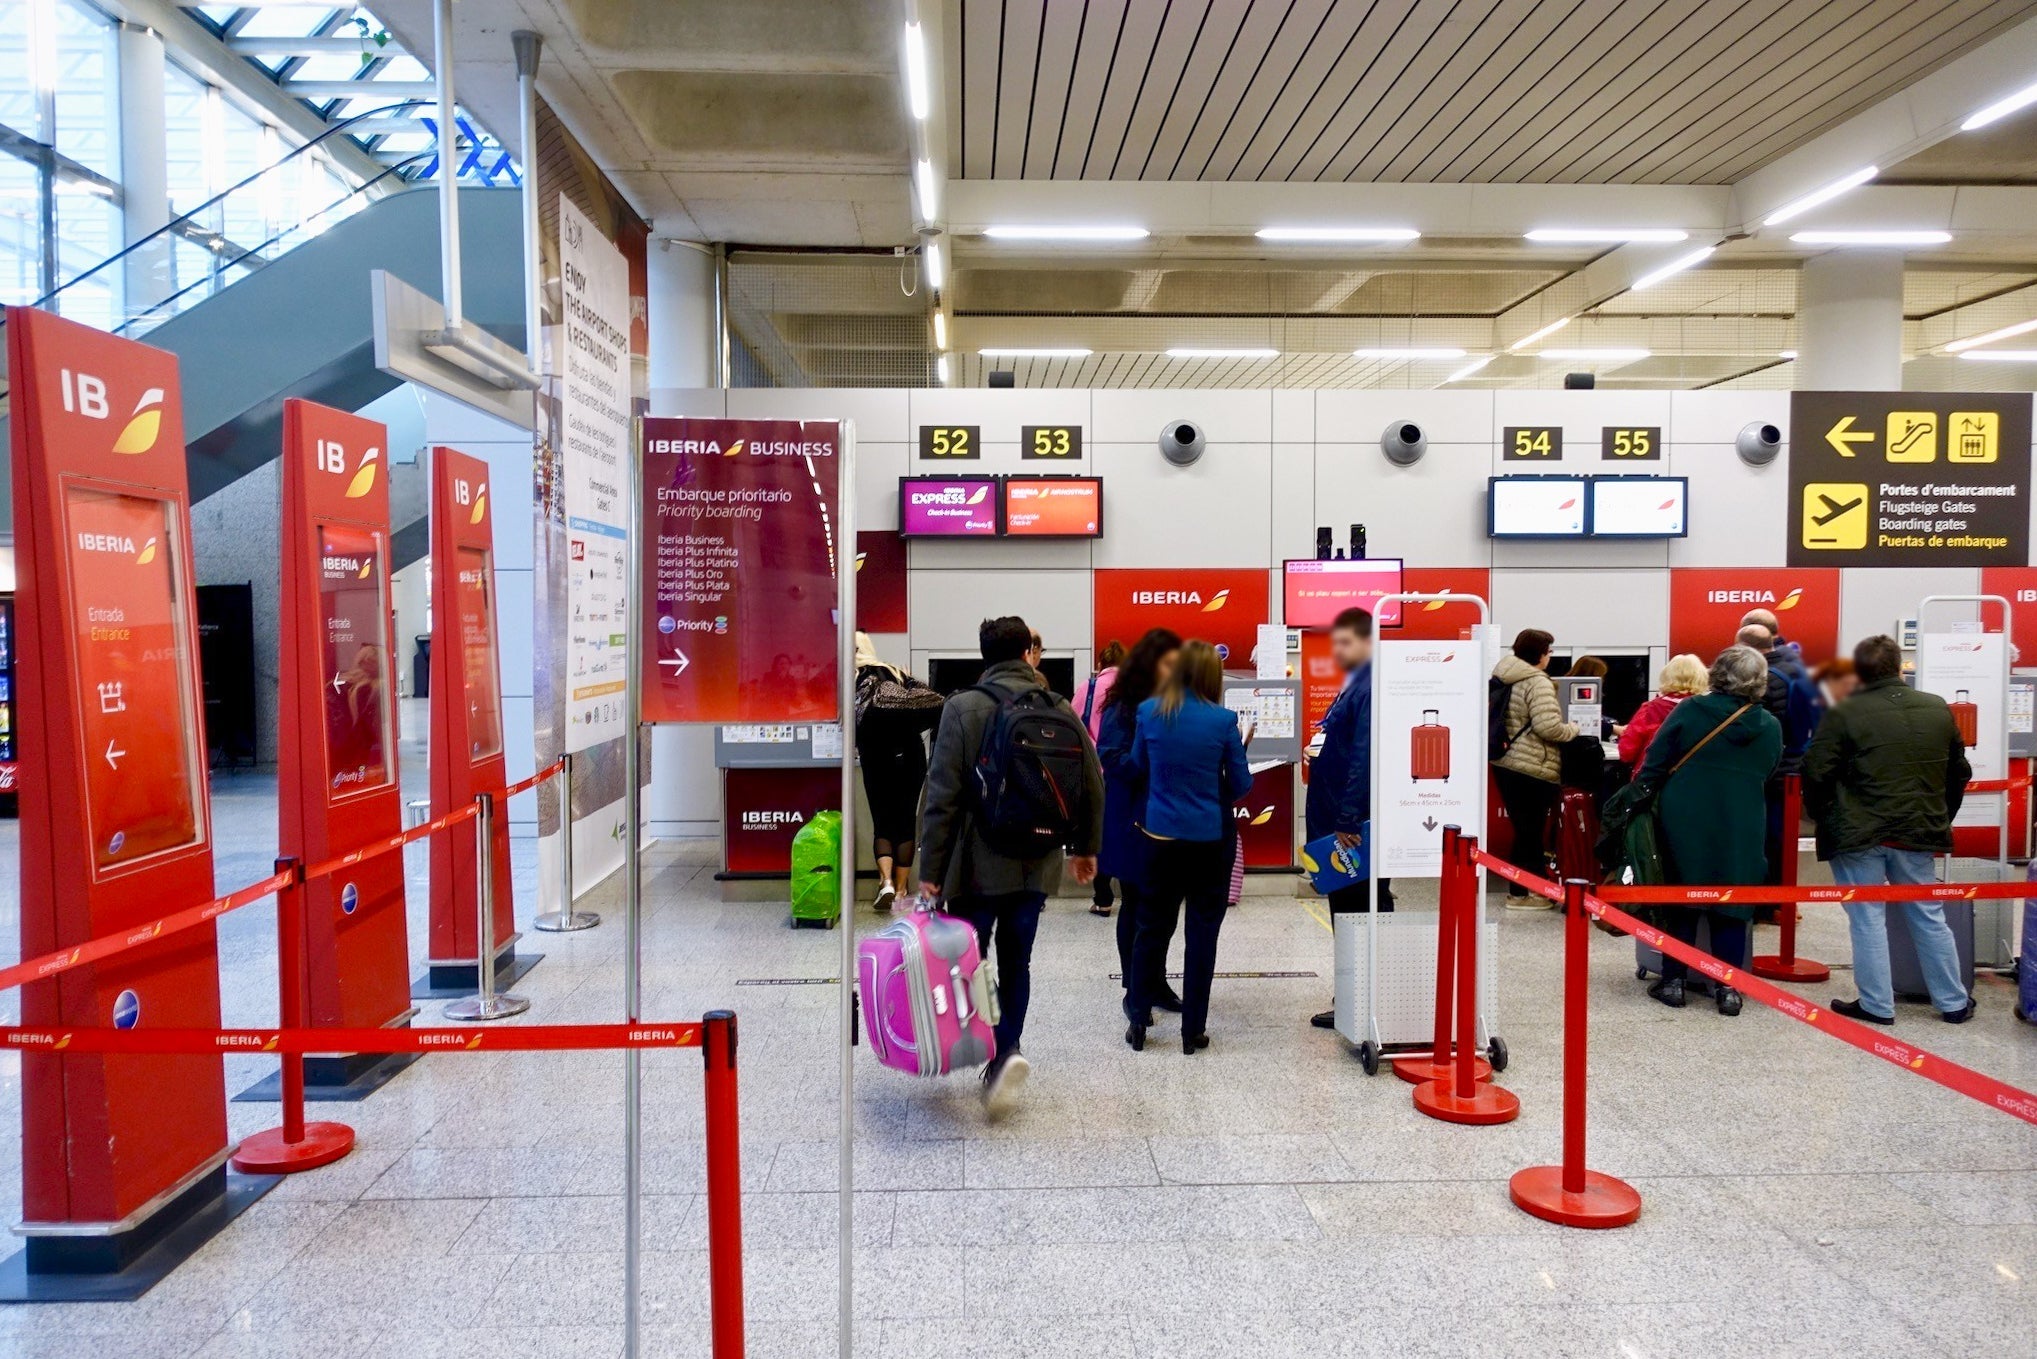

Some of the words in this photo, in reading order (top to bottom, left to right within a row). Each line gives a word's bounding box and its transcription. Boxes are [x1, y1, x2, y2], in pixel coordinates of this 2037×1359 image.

[566, 262, 586, 294] ENJOY
[566, 292, 580, 318] THE
[61, 369, 109, 419] IB
[649, 440, 720, 454] IBERIA
[750, 442, 832, 456] BUSINESS
[932, 429, 968, 455] 52
[1034, 429, 1070, 455] 53
[1515, 430, 1551, 456] 54
[1614, 430, 1650, 456] 55
[318, 439, 344, 474] IB
[454, 479, 469, 505] IB
[658, 488, 725, 502] Embarque
[729, 488, 792, 504] prioritario
[1880, 484, 1918, 496] Portes
[1921, 484, 2016, 496] d'embarcament
[912, 494, 966, 504] EXPRESS
[658, 504, 702, 521] Priority
[706, 505, 762, 521] boarding
[1879, 501, 1938, 515] Flugsteige
[1942, 501, 1976, 512] Gates
[1879, 518, 1932, 532] Boarding
[1935, 519, 1967, 532] gates
[78, 533, 136, 554] IBERIA
[658, 536, 683, 544] Iberia
[686, 536, 724, 544] Business
[1878, 535, 1924, 547] Puertas
[1928, 535, 1943, 547] de
[1946, 536, 2007, 549] embarque
[658, 548, 683, 556] Iberia
[686, 548, 704, 556] Plus
[706, 548, 738, 556] Infinita
[322, 557, 358, 571] IBERIA
[658, 558, 683, 568] Iberia
[686, 558, 704, 568] Plus
[706, 558, 738, 568] Platino
[658, 570, 683, 578] Iberia
[686, 570, 704, 578] Plus
[706, 570, 722, 578] Oro
[658, 581, 683, 590] Iberia
[686, 581, 704, 590] Plus
[706, 581, 730, 590] Plata
[658, 592, 683, 601] Iberia
[685, 592, 722, 603] Singular
[1132, 591, 1202, 604] IBERIA
[1708, 590, 1774, 603] IBERIA
[88, 607, 124, 622] Entrada
[328, 618, 350, 630] Entrada
[677, 620, 714, 632] Priority
[91, 627, 130, 641] Entrance
[330, 632, 354, 642] Entrance
[742, 811, 804, 823] IBERIA
[1810, 890, 1842, 898] IBERIA
[1932, 888, 1964, 896] IBERIA
[128, 932, 152, 944] EXPRESS
[38, 959, 69, 974] EXPRESS
[1778, 998, 1806, 1018] EXPRESS
[8, 1034, 54, 1044] IBERIA
[216, 1036, 262, 1046] IBERIA
[418, 1035, 464, 1045] IBERIA
[629, 1030, 676, 1041] IBERIA
[1874, 1042, 1910, 1066] EXPRESS
[1997, 1094, 2037, 1118] EXPRES
